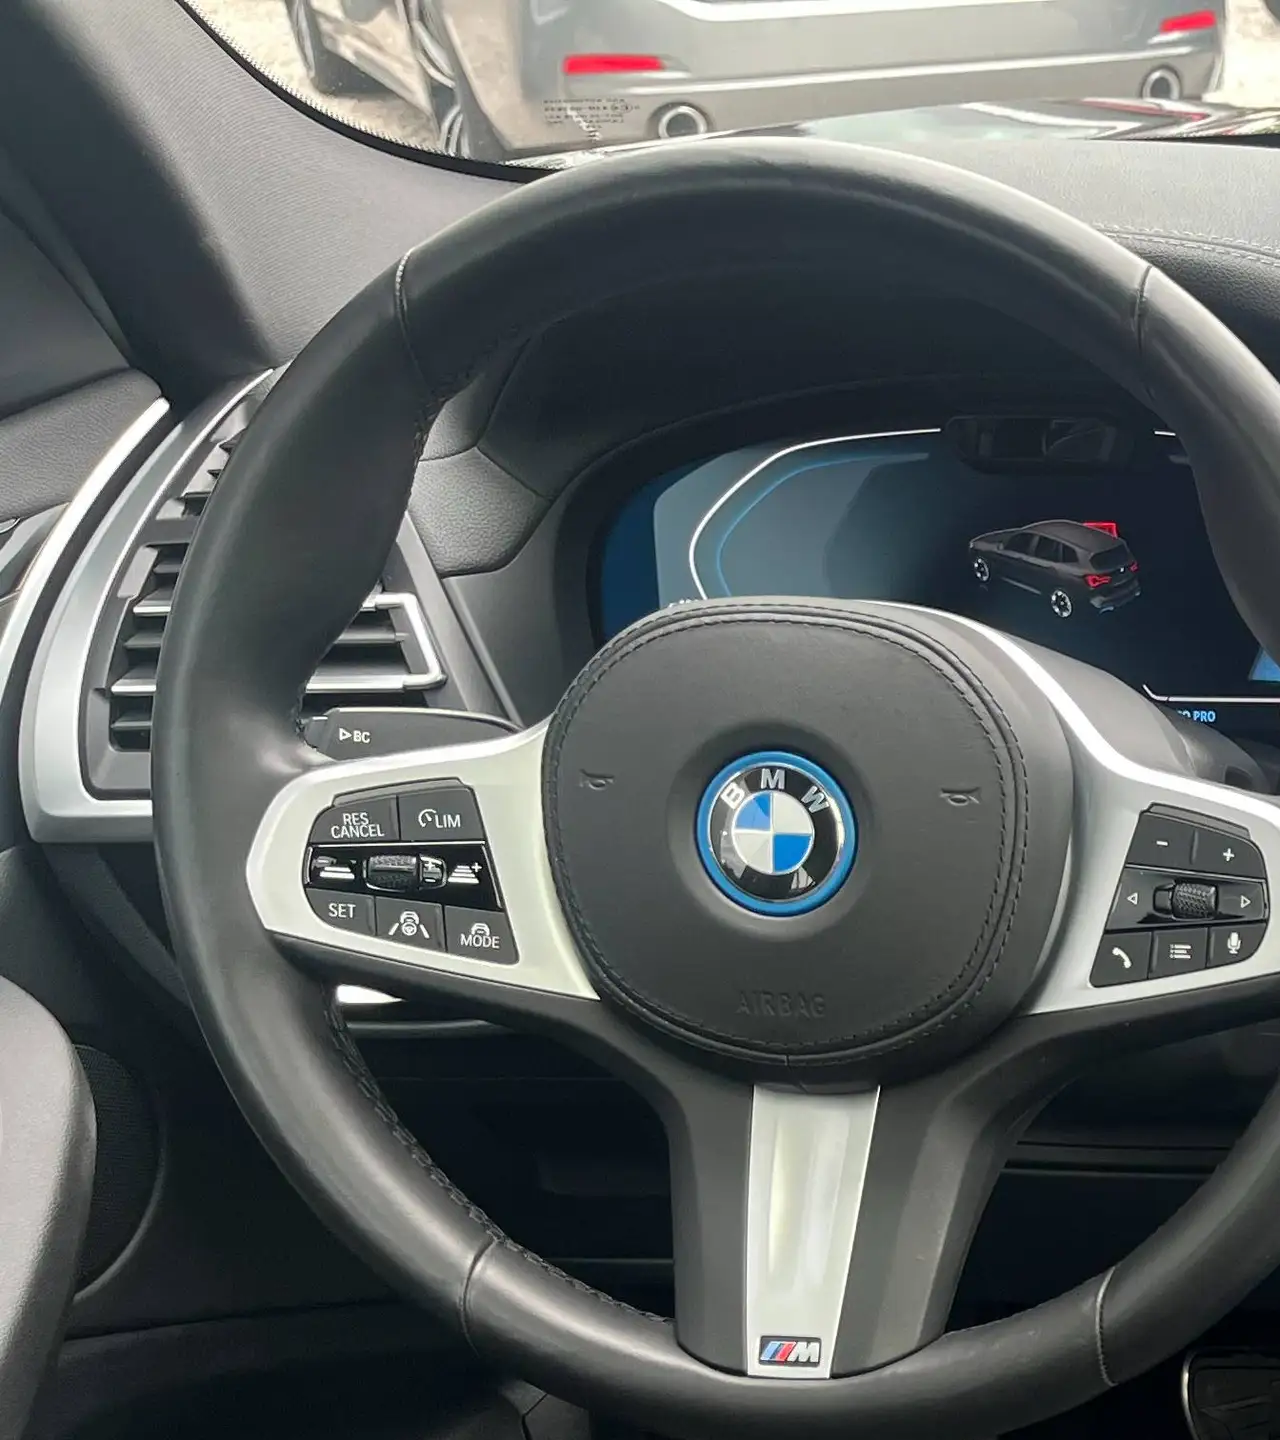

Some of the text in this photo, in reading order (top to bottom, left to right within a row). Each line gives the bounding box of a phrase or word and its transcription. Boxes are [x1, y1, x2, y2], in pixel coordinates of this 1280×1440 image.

[1193, 709, 1217, 723] PRO
[353, 729, 371, 744] BC
[720, 768, 830, 814] BMW
[342, 812, 370, 826] RES
[435, 814, 461, 828] LIM
[331, 824, 385, 839] CANCEL
[328, 903, 357, 918] SET
[460, 933, 501, 949] MODE
